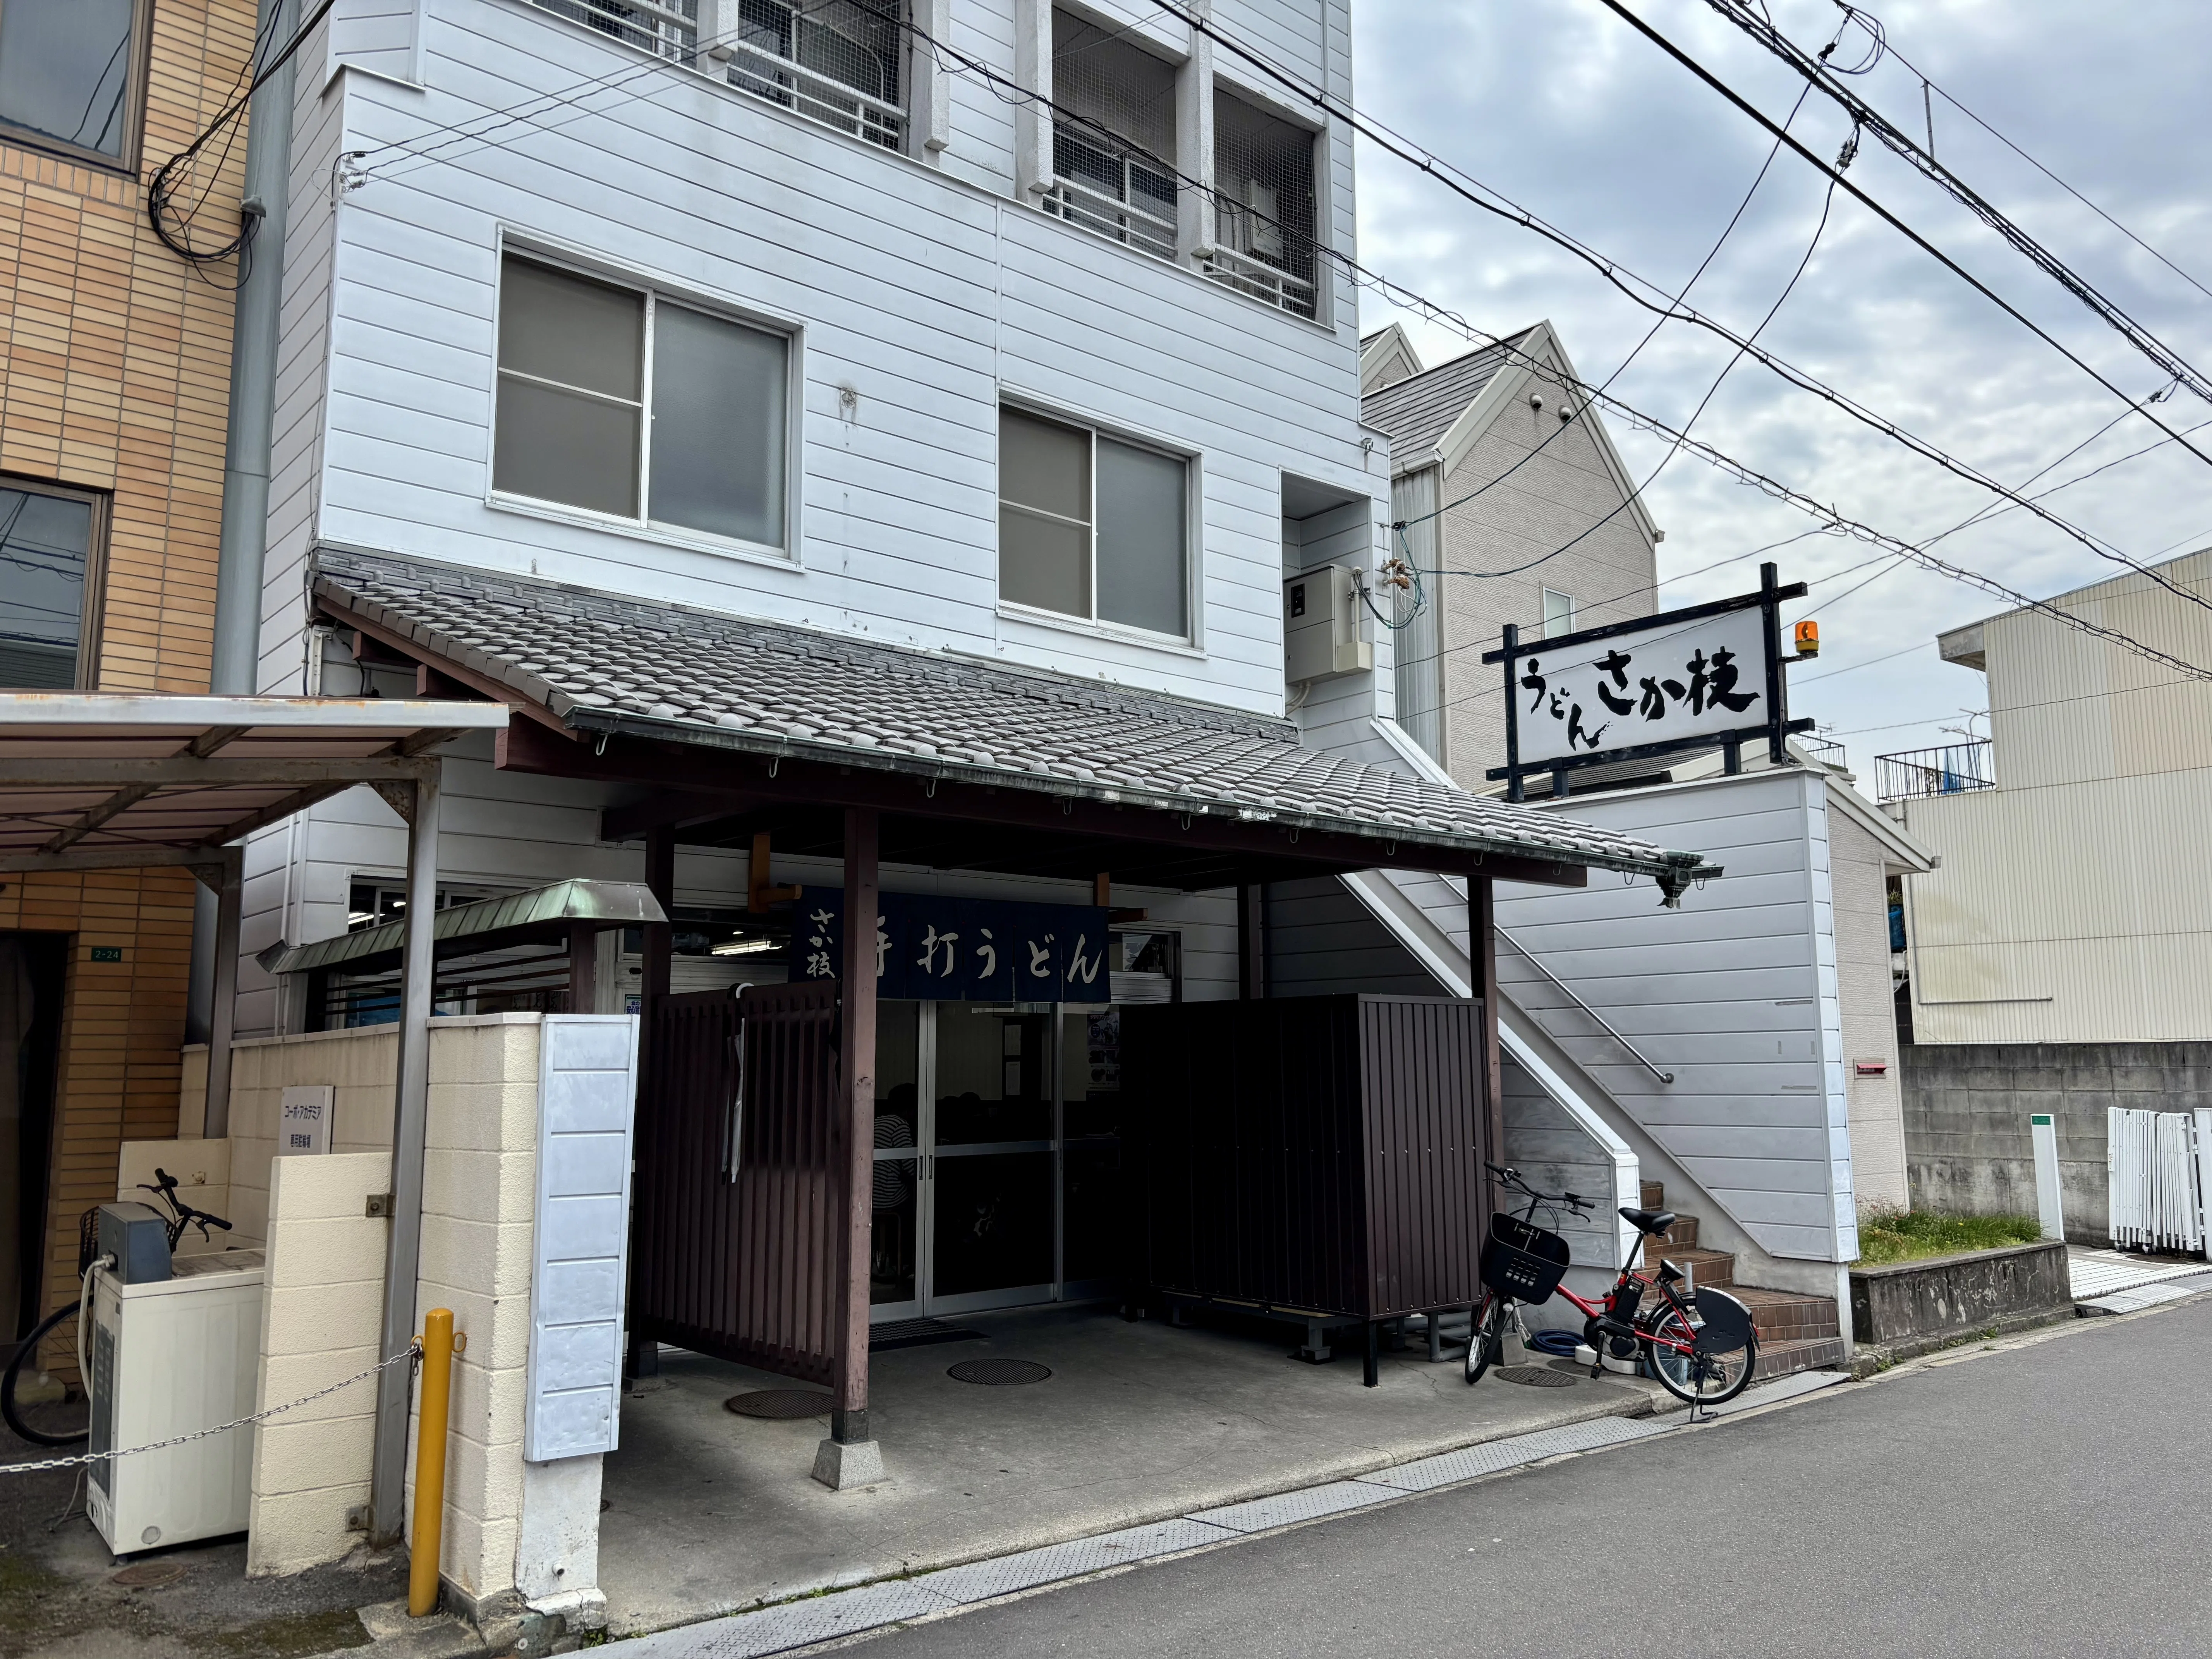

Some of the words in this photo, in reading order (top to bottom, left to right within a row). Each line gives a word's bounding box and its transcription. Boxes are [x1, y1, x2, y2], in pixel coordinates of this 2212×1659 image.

[1521, 658, 1613, 752] うどん
[1592, 646, 1760, 723] さか枝
[95, 950, 118, 958] 2-24
[807, 908, 835, 979] さか枝
